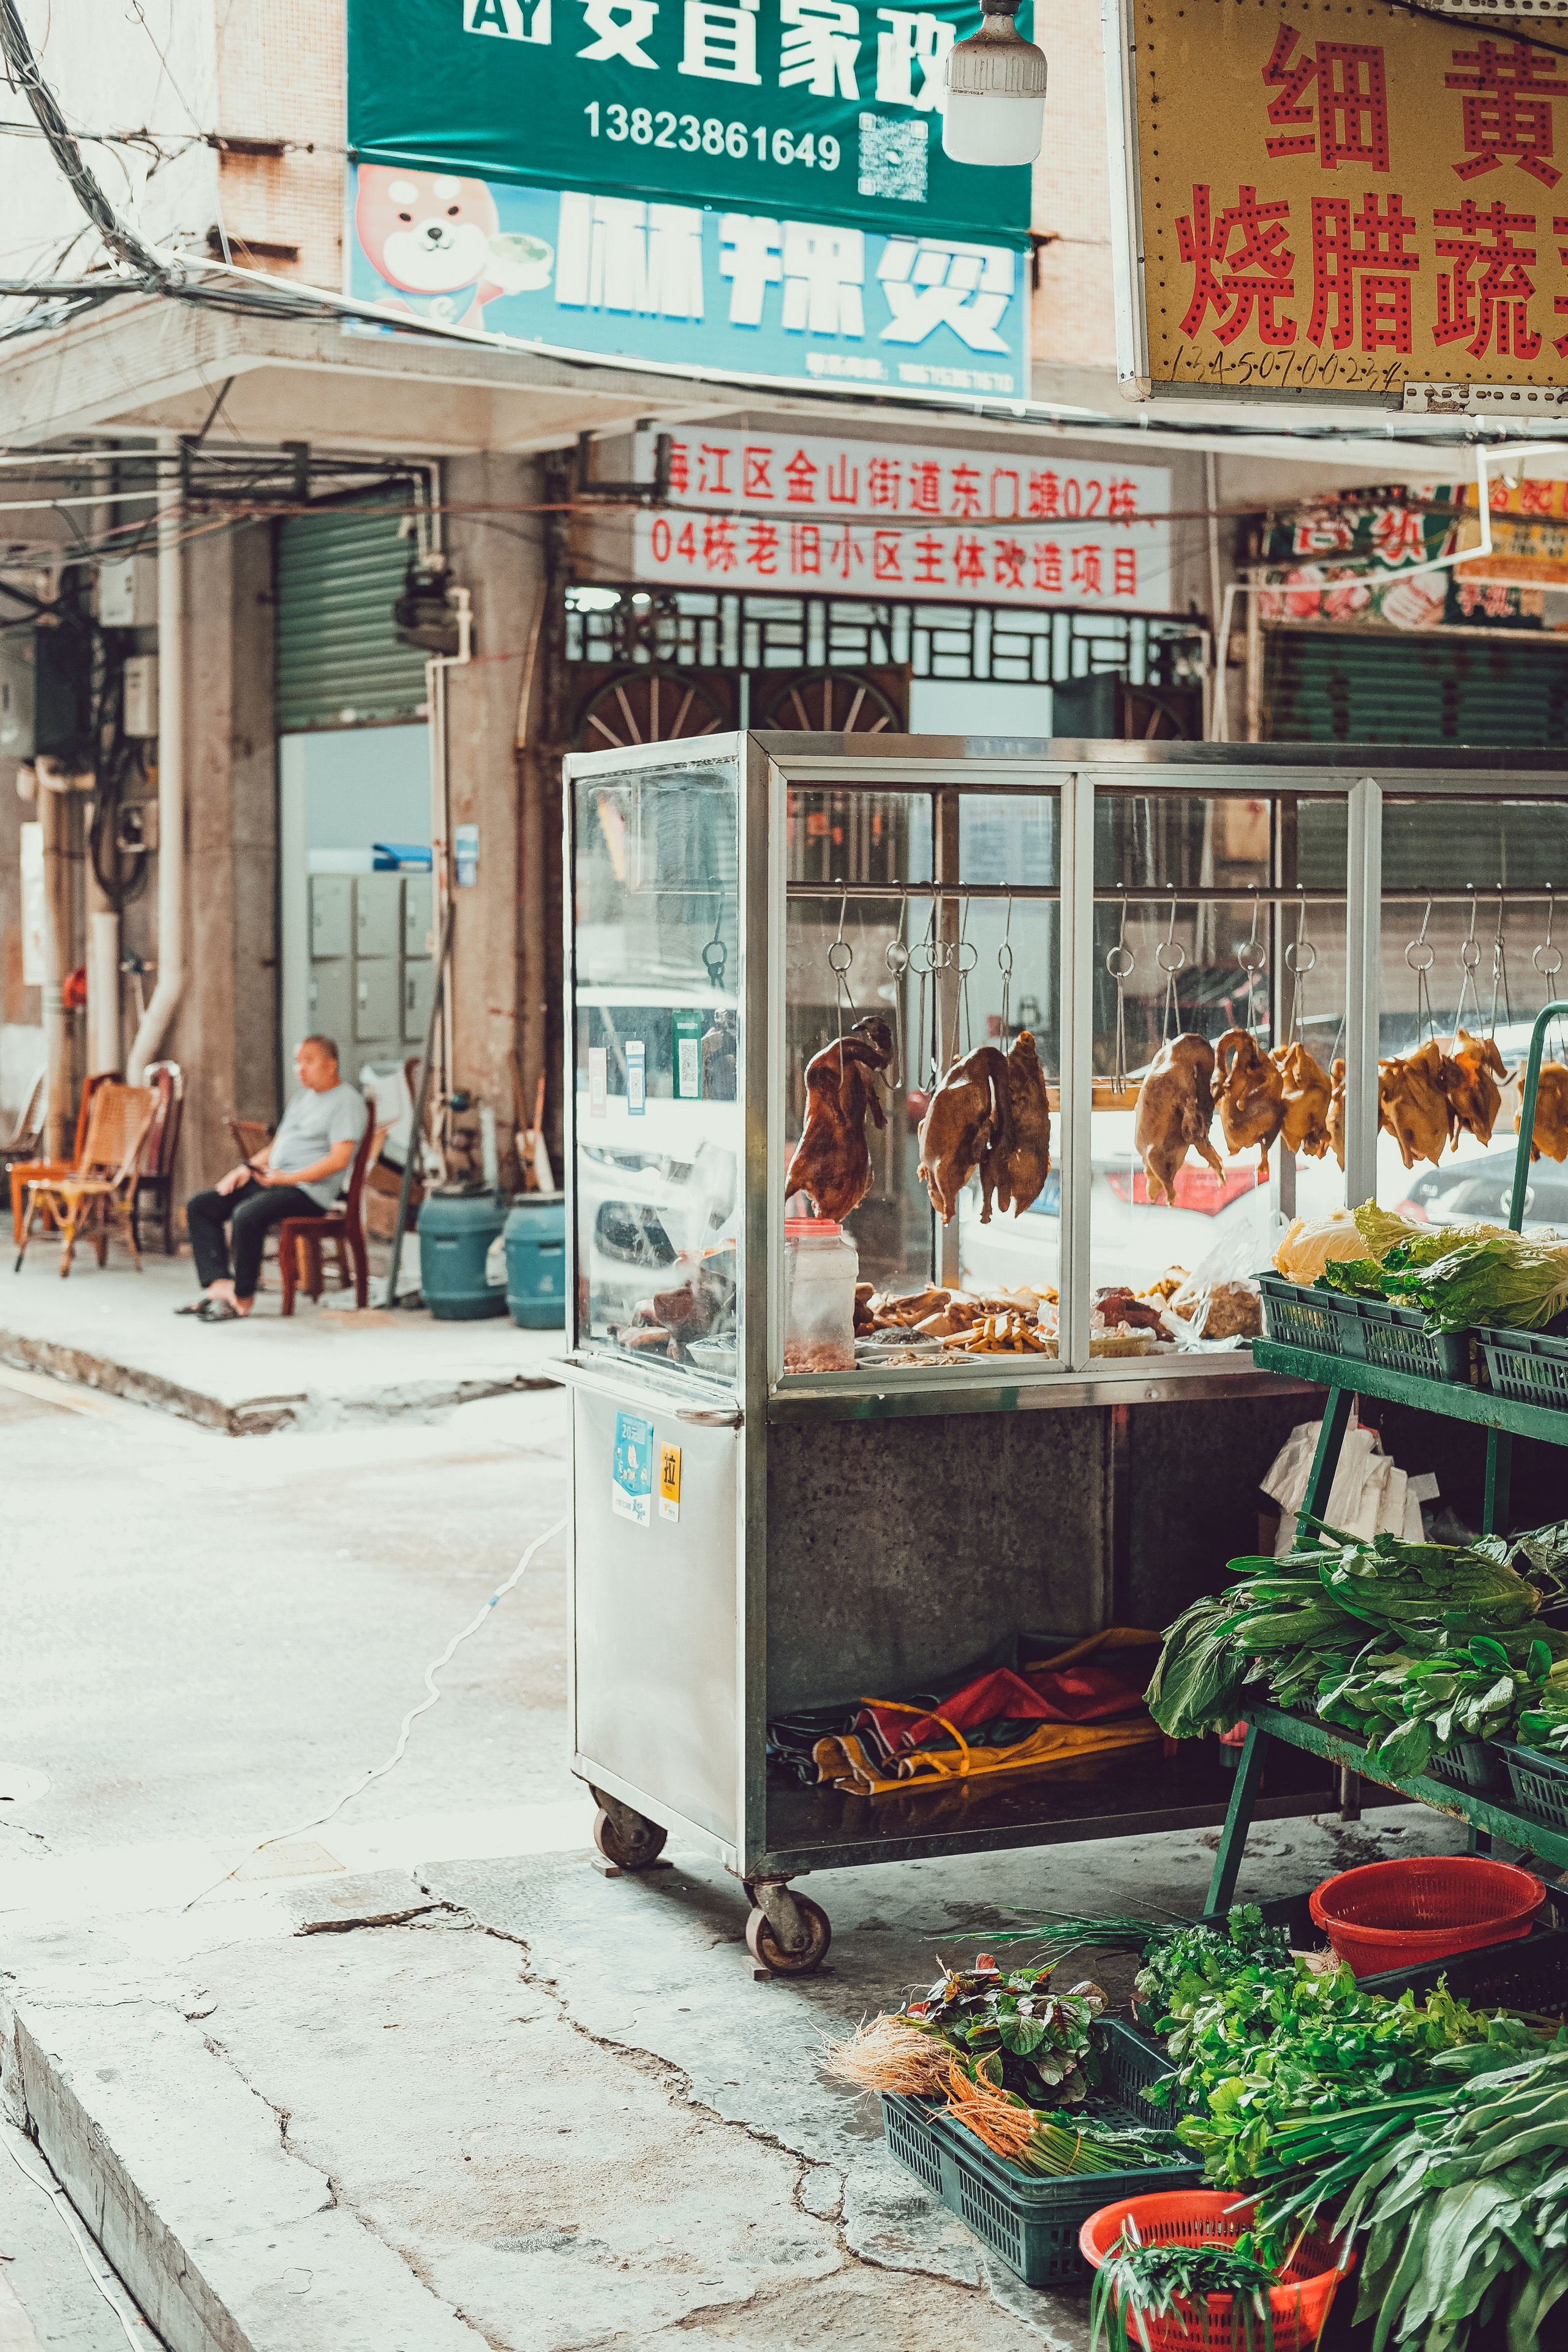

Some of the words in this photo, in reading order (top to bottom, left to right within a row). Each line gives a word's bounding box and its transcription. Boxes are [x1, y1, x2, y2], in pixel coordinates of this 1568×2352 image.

[584, 101, 841, 172] 13823861649
[1175, 184, 1568, 360] 烧腊蔬
[651, 514, 1136, 596] 04栋老旧小区主体改造项目
